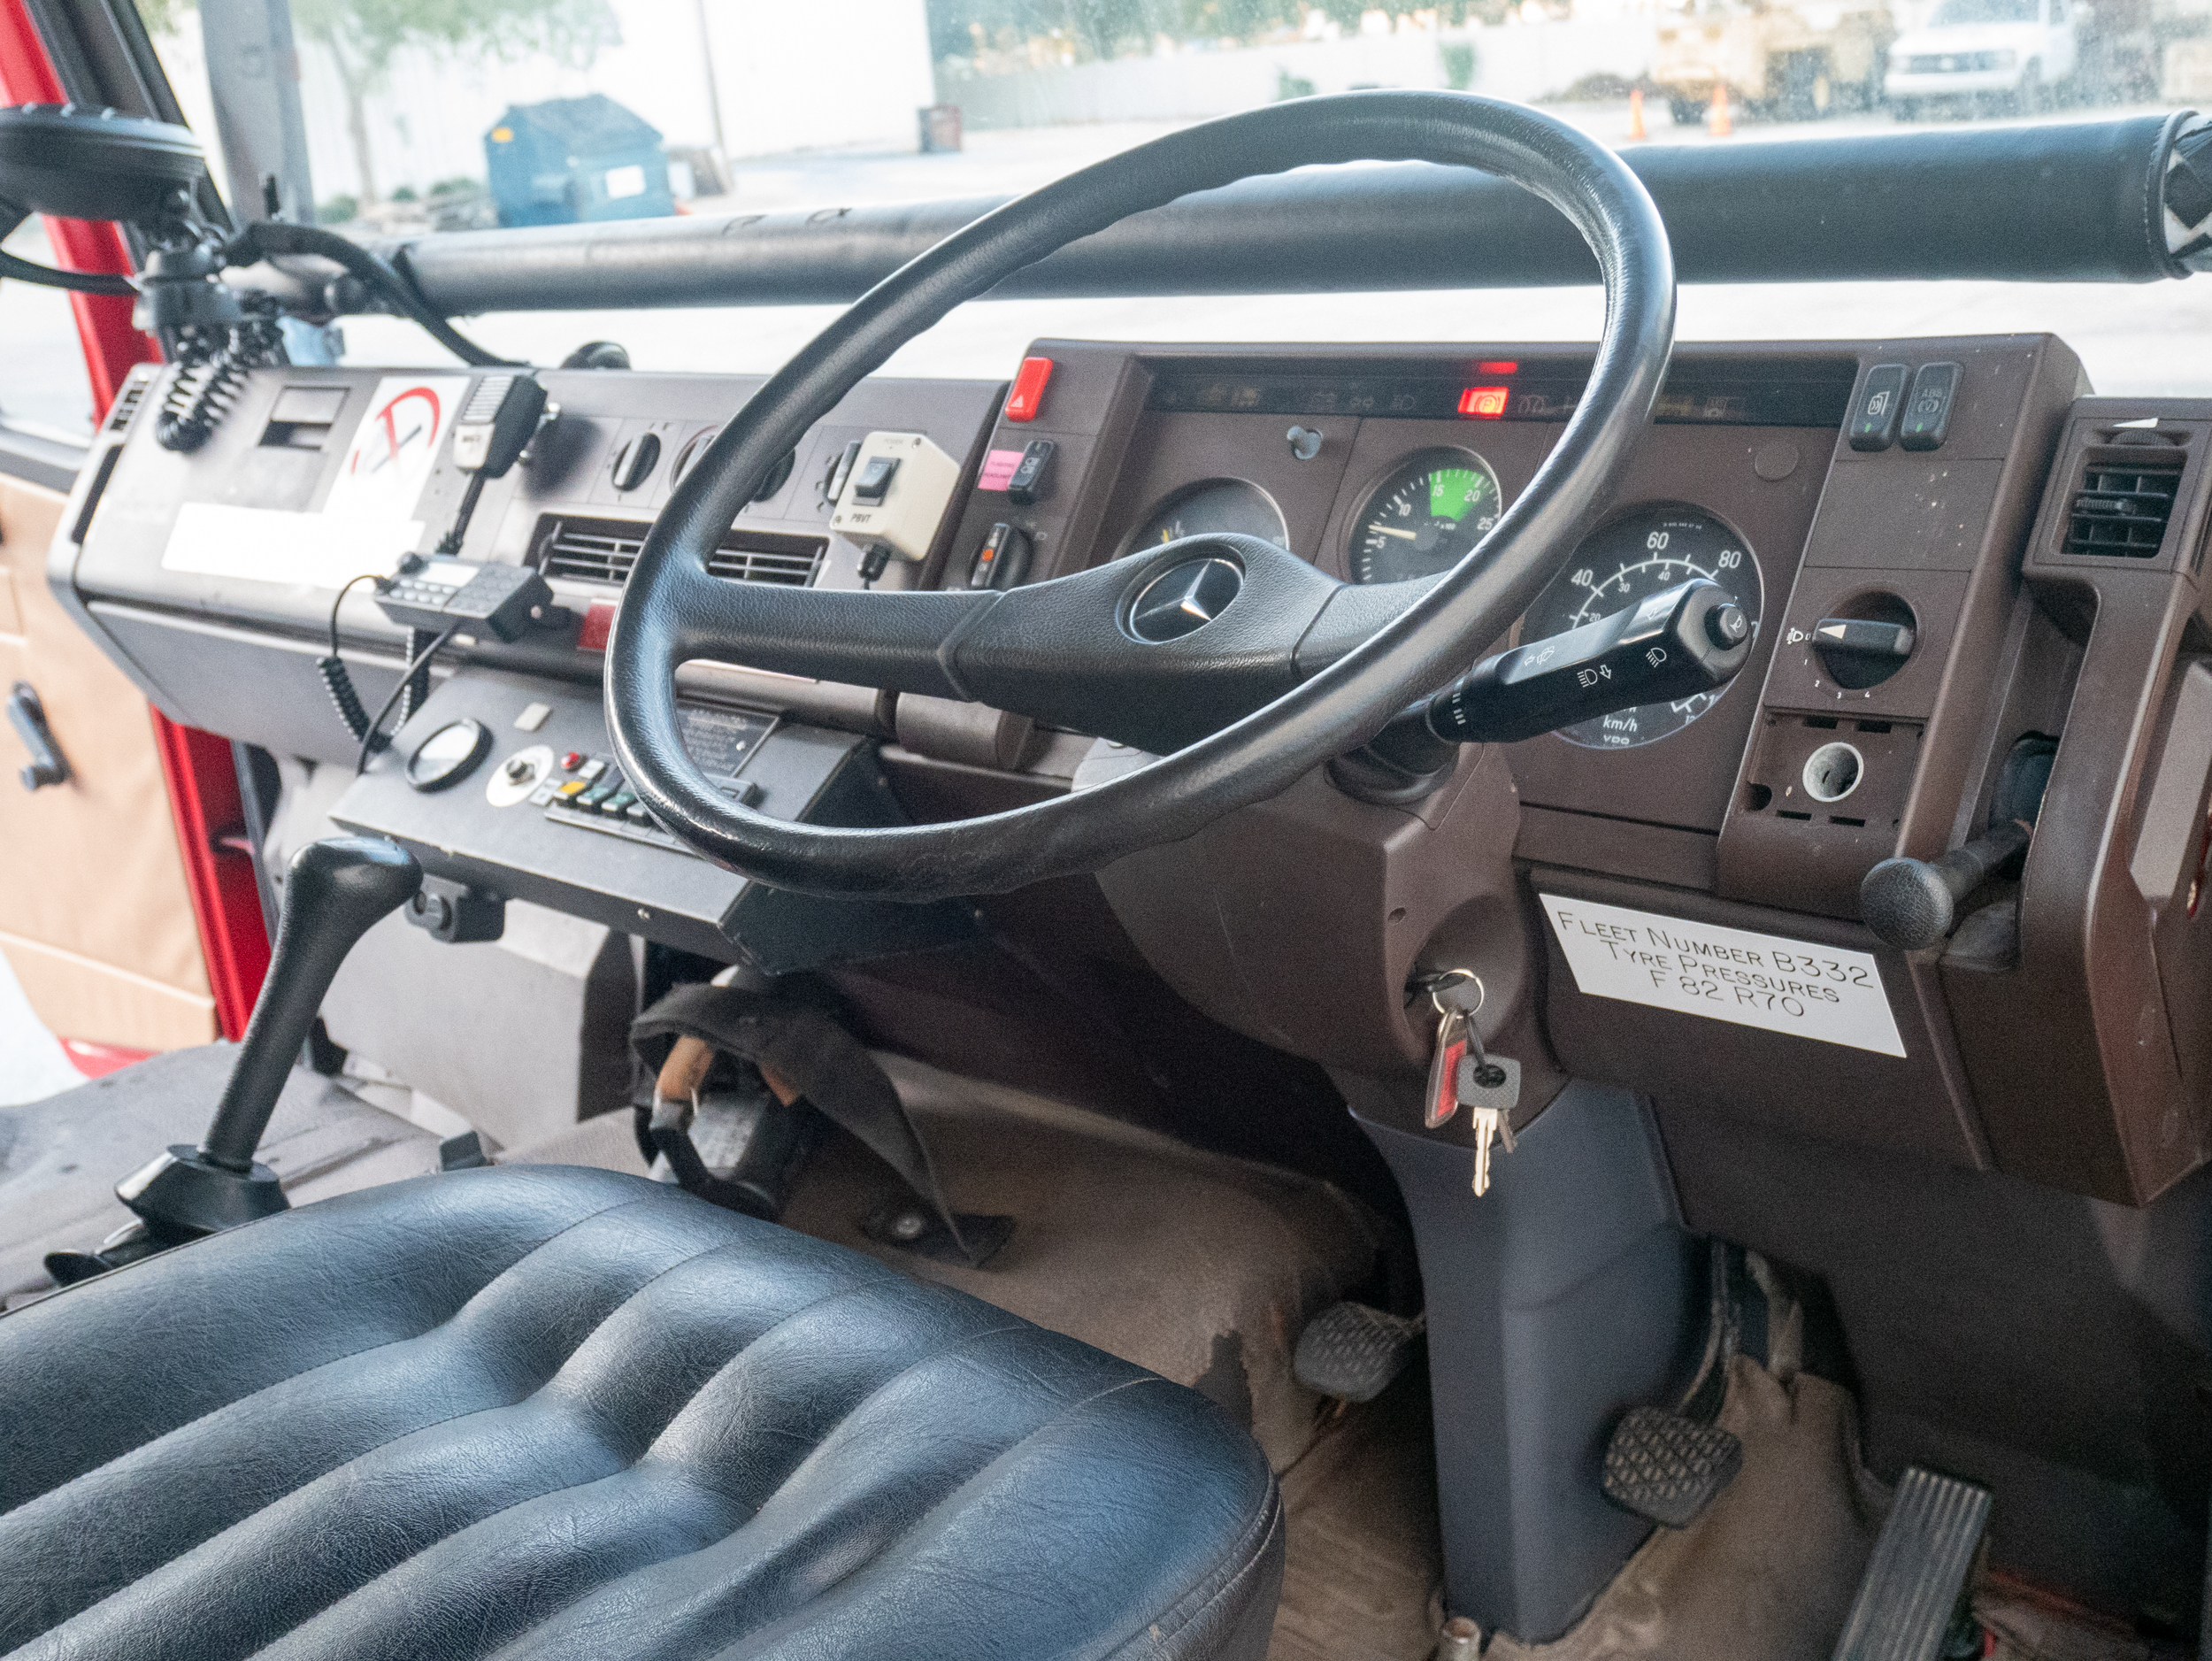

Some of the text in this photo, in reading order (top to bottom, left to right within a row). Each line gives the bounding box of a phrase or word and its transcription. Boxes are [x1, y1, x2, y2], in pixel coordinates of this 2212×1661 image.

[1432, 484, 1445, 497] 15
[1463, 489, 1481, 502] 20
[1398, 504, 1412, 517] 10
[1477, 516, 1493, 531] 25
[1376, 536, 1386, 549] 5
[1647, 531, 1670, 550] 60
[1717, 550, 1741, 569] 80
[1571, 568, 1594, 587] 40
[1657, 571, 1671, 581] 40
[1618, 582, 1631, 593] 30
[1589, 612, 1601, 622] 20
[1602, 714, 1638, 733] km/h
[1602, 734, 1630, 745] VDO
[1557, 911, 1875, 988] FLEET NUMBER B332
[1600, 940, 1840, 1004] TYRE PRESSURES
[1651, 970, 1666, 988] F
[1681, 976, 1724, 1002] 82
